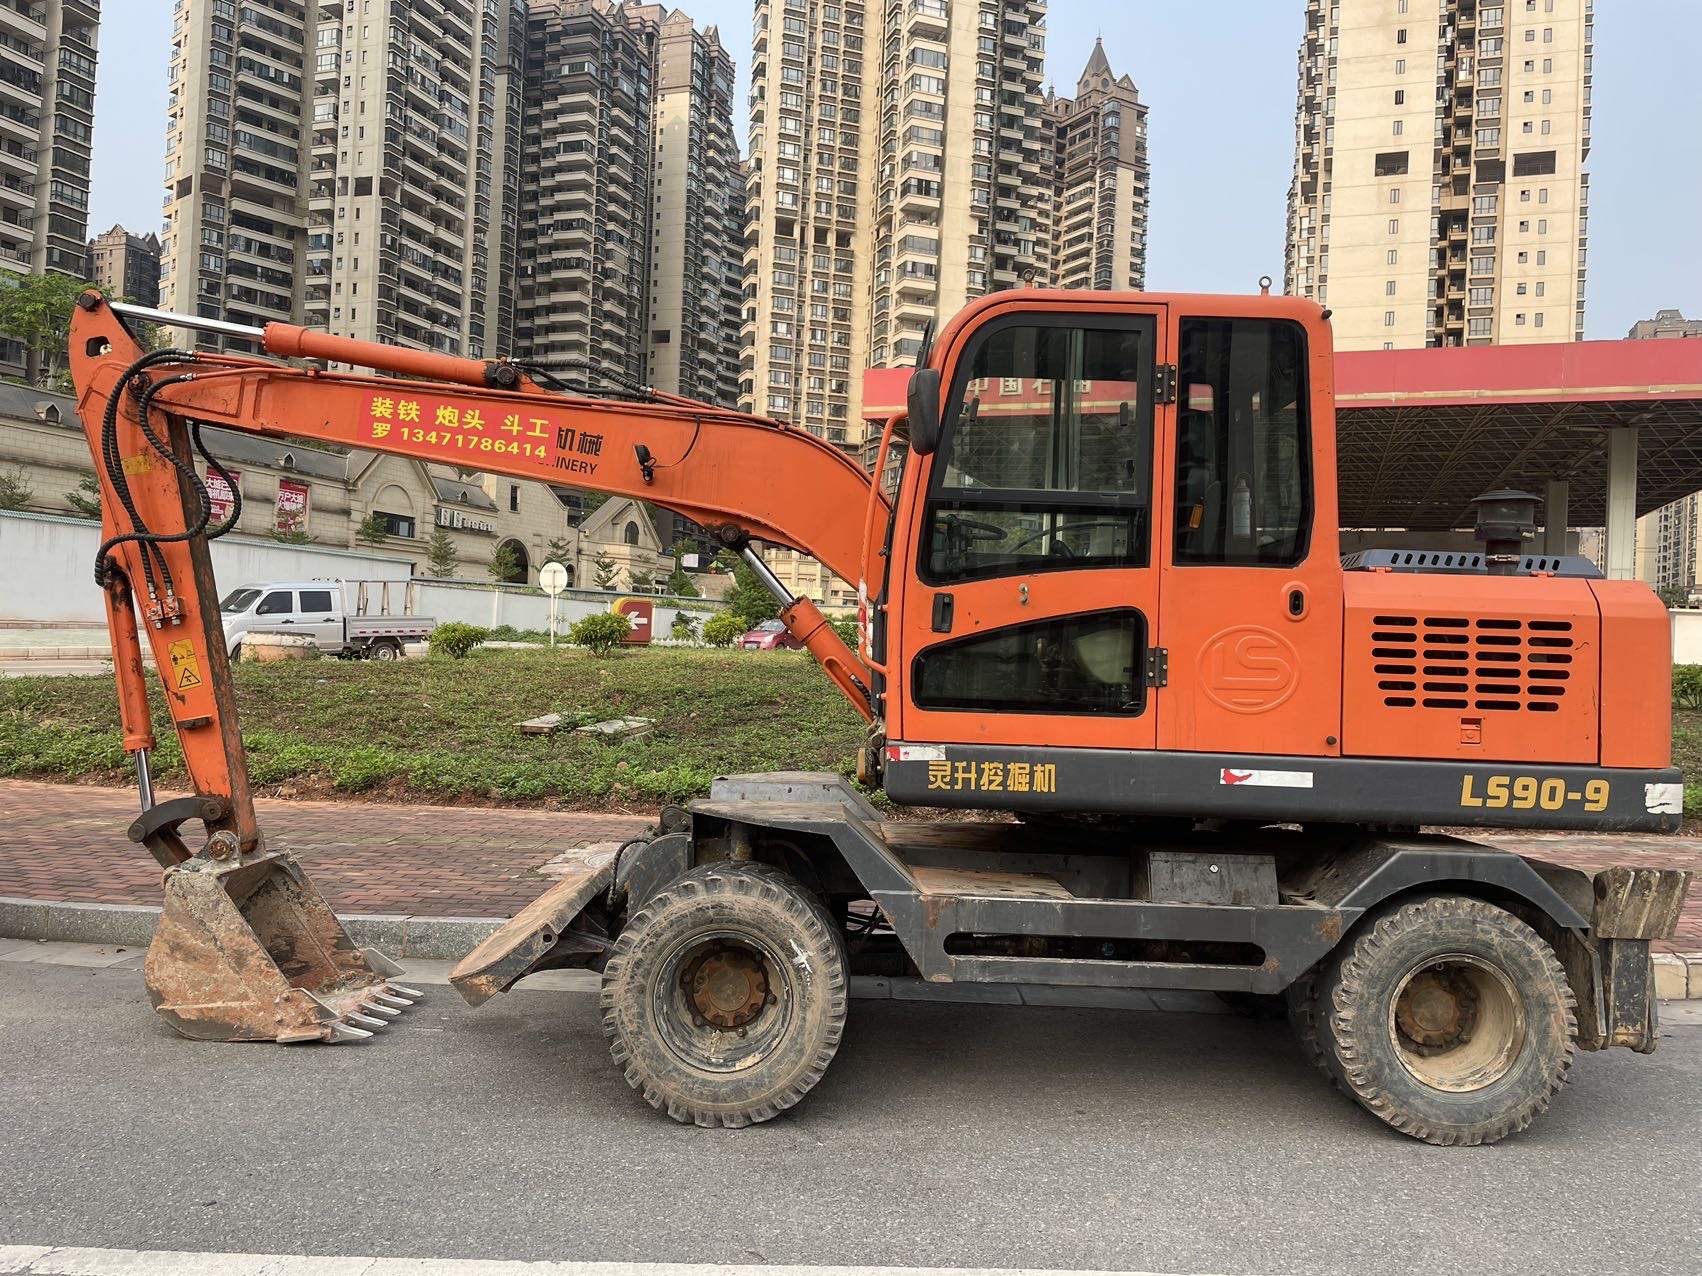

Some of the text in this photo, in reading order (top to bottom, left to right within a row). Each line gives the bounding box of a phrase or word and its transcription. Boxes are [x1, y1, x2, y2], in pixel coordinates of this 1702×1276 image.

[370, 396, 551, 438] 装铁 炮头 斗工
[371, 421, 547, 459] 罗 13471786414
[540, 455, 598, 475] INERY
[927, 760, 1057, 793] 灵升挖掘机
[1460, 774, 1610, 812] LS90-9
